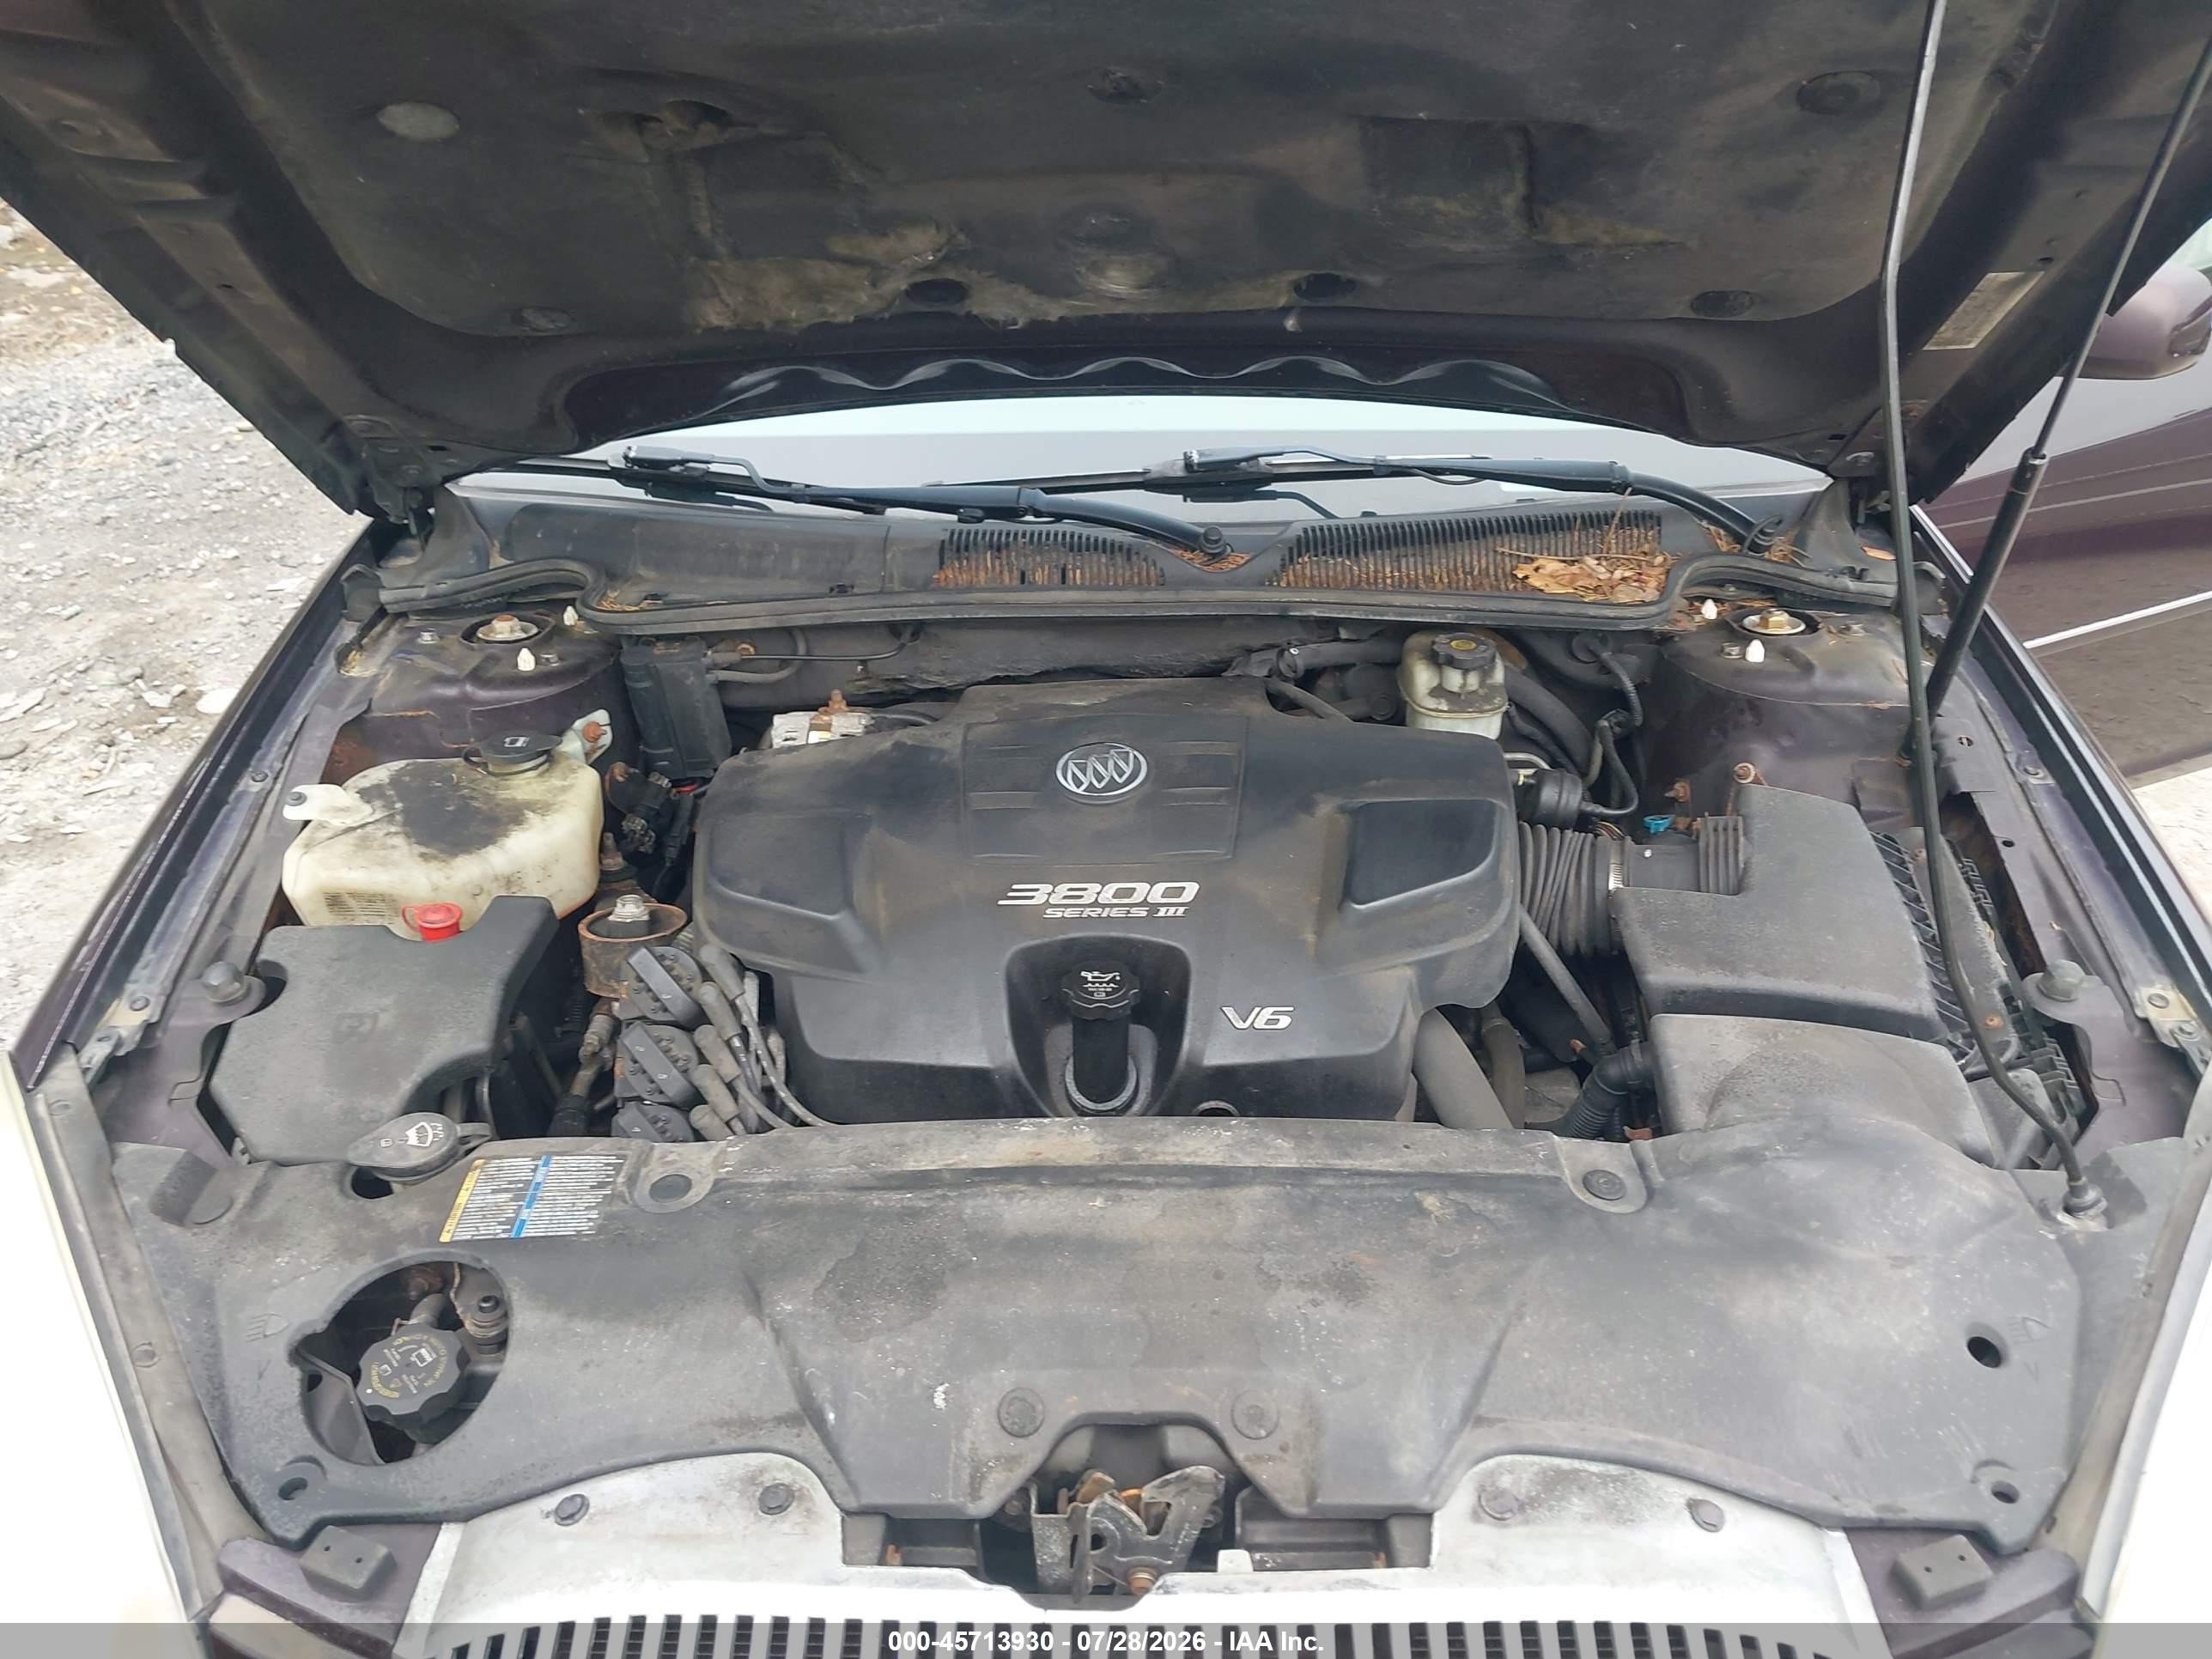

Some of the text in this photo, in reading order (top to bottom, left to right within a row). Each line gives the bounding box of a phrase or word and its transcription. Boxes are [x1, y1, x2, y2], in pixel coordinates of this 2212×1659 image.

[997, 882, 1200, 905] 3800
[1042, 906, 1189, 919] SERIES III
[1220, 1006, 1295, 1030] V6
